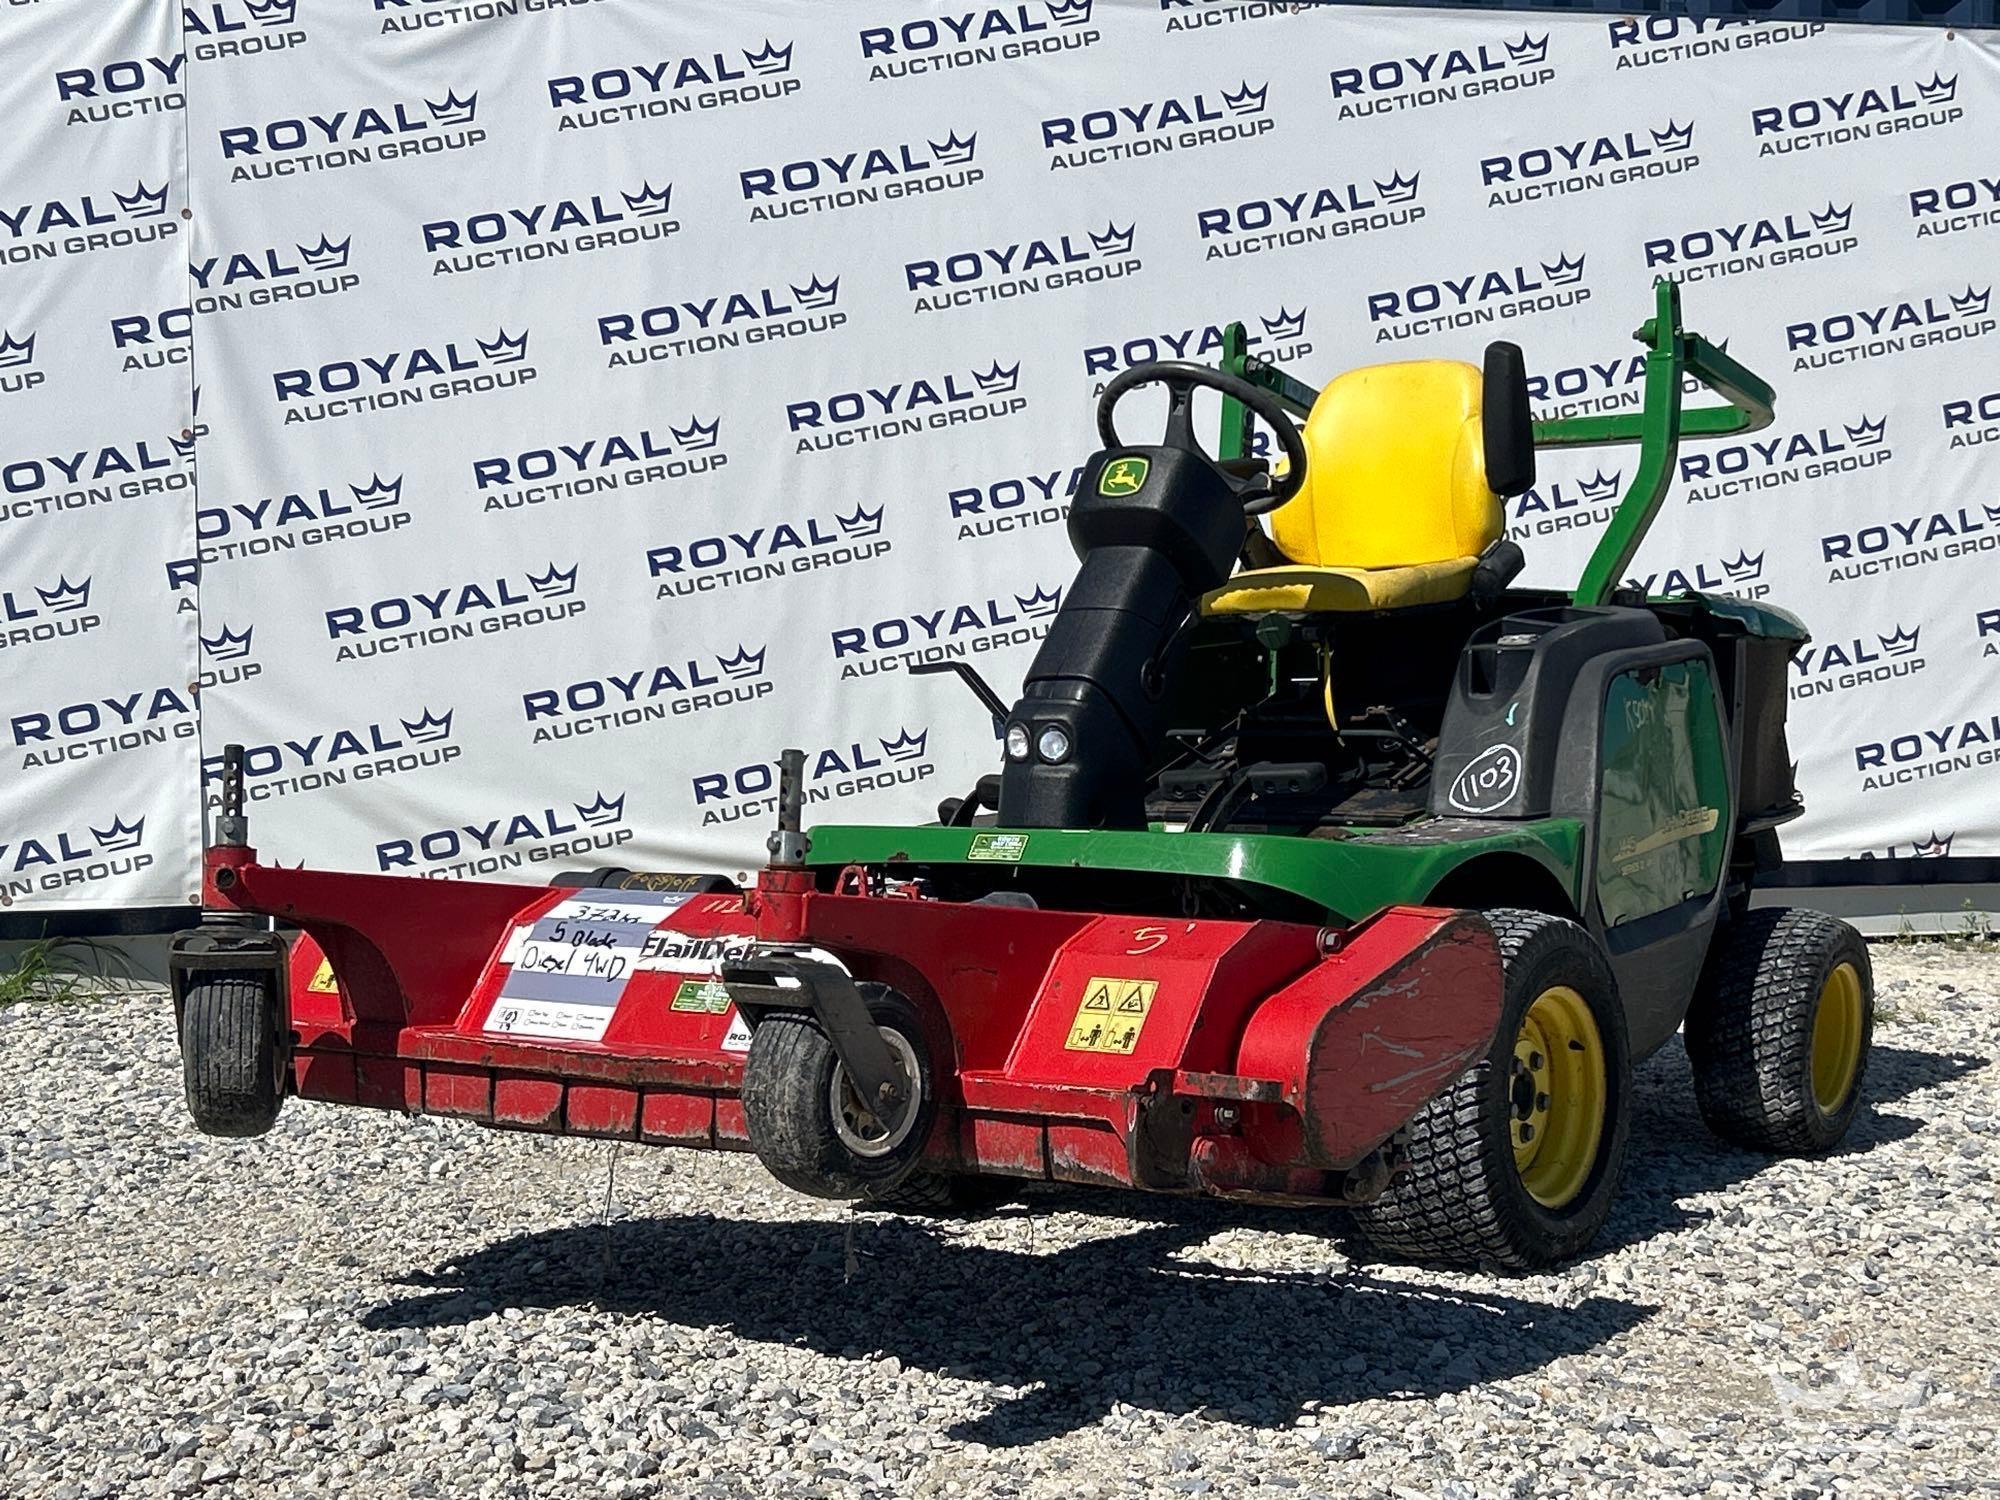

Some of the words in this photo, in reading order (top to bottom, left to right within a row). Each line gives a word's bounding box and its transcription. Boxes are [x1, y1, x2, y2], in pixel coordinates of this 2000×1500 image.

[380, 1, 519, 34] AUCTION
[859, 4, 1048, 59] ROYAL
[1165, 1, 1289, 33] AUCTION
[1607, 16, 1770, 50] ROY
[194, 30, 307, 62] GROUP
[868, 45, 997, 82] AUCTION
[1001, 29, 1101, 60] GROUP
[1329, 44, 1507, 99] ROYAL
[1615, 36, 1731, 71] AUCTION
[1735, 22, 1826, 50] GROUP
[55, 53, 187, 102] ROY
[547, 52, 746, 109] ROYAL
[1337, 85, 1458, 122] AUCTION
[1462, 68, 1556, 99] GROUP
[66, 93, 186, 127] AUCTIO
[218, 103, 429, 160] ROYAL
[557, 95, 692, 133] AUCTION
[697, 78, 802, 110] GROUP
[1040, 94, 1224, 149] ROYAL
[1751, 84, 1918, 137] ROYAL
[1758, 123, 1872, 158] AUCTION
[1875, 107, 1964, 136] GROUP
[230, 146, 372, 184] AUCTION
[377, 128, 487, 161] GROUP
[739, 143, 931, 201] ROYAL
[1050, 135, 1174, 172] AUCTION
[1178, 118, 1275, 149] GROUP
[1479, 132, 1652, 187] ROYAL
[749, 186, 879, 223] AUCTION
[883, 168, 985, 200] GROUP
[1487, 172, 1605, 209] AUCTION
[1609, 155, 1700, 185] GROUP
[1908, 177, 2000, 218] ROY
[0, 195, 117, 239] YAL
[63, 221, 179, 255] GROUP
[421, 195, 625, 253] ROYAL
[1197, 183, 1376, 240] ROYAL
[1205, 224, 1327, 262] AUCTION
[1331, 206, 1426, 238] GROUP
[1916, 208, 2000, 239] AUCTIO
[189, 248, 301, 289] YAL
[432, 238, 570, 277] AUCTION
[574, 220, 681, 252] GROUP
[904, 235, 1091, 292] ROYAL
[1643, 214, 1812, 269] ROYAL
[1769, 236, 1859, 267] GROUP
[248, 273, 360, 306] GROUP
[913, 276, 1040, 315] AUCTION
[1044, 258, 1142, 290] GROUP
[1367, 266, 1543, 323] ROYAL
[596, 288, 793, 346] ROYAL
[607, 330, 740, 369] AUCTION
[745, 312, 848, 344] GROUP
[1375, 306, 1495, 344] AUCTION
[1499, 288, 1592, 319] GROUP
[1785, 297, 1951, 352] ROYAL
[272, 343, 480, 402] ROYAL
[1083, 324, 1262, 377] ROYA
[1257, 342, 1313, 366] OUP
[1792, 336, 1905, 373] AUCTION
[1909, 319, 1997, 349] GROUP
[283, 386, 424, 426] AUCTION
[428, 367, 538, 400] GROUP
[785, 374, 975, 433] ROYAL
[1526, 354, 1648, 402] ROYA
[795, 416, 923, 455] AUCTION
[927, 397, 1028, 430] GROUP
[2, 440, 172, 494] OYAL
[472, 430, 673, 490] ROYAL
[483, 473, 619, 513] AUCTION
[623, 453, 728, 486] GROUP
[1678, 428, 1846, 484] ROYAL
[1686, 467, 1800, 505] AUCTION
[1804, 449, 1893, 480] GROUP
[118, 471, 198, 500] GRO
[947, 466, 1085, 519] ROY
[197, 488, 353, 541] OYAL
[200, 532, 296, 565] CTION
[301, 511, 412, 546] GROUP
[1820, 507, 1985, 564] ROYAL
[645, 518, 839, 578] ROYAL
[655, 560, 786, 601] AUCTION
[791, 540, 892, 573] GROUP
[1828, 546, 1939, 584] AUCTION
[1943, 534, 2000, 559] GRO
[324, 578, 530, 640] ROYAL
[335, 621, 475, 663] AUCTION
[479, 599, 587, 635] GROUP
[831, 599, 1018, 659] ROYAL
[201, 662, 262, 689] OUP
[840, 640, 967, 681] AUCTION
[971, 623, 1051, 653] GROU
[1792, 639, 1880, 677] YAL
[1838, 658, 1926, 690] GROUP
[9, 686, 199, 747] ROYA
[522, 659, 720, 722] ROYAL
[532, 702, 666, 745] AUCTION
[671, 680, 774, 716] GROUP
[21, 726, 167, 771] AUCTION
[691, 742, 882, 806] ROAL
[1861, 754, 1972, 793] AUCTION
[206, 767, 347, 811] ACTION
[352, 745, 462, 781] GROUP
[701, 785, 830, 828] AUCTN
[835, 763, 935, 798] GROUP
[1460, 754, 1514, 803] 1103
[375, 808, 578, 873] ROYAL
[528, 827, 634, 863] GROUP
[39, 853, 154, 891] GROUP
[548, 920, 569, 943] 5
[583, 951, 627, 983] 4WD
[729, 1032, 754, 1042] ROY
